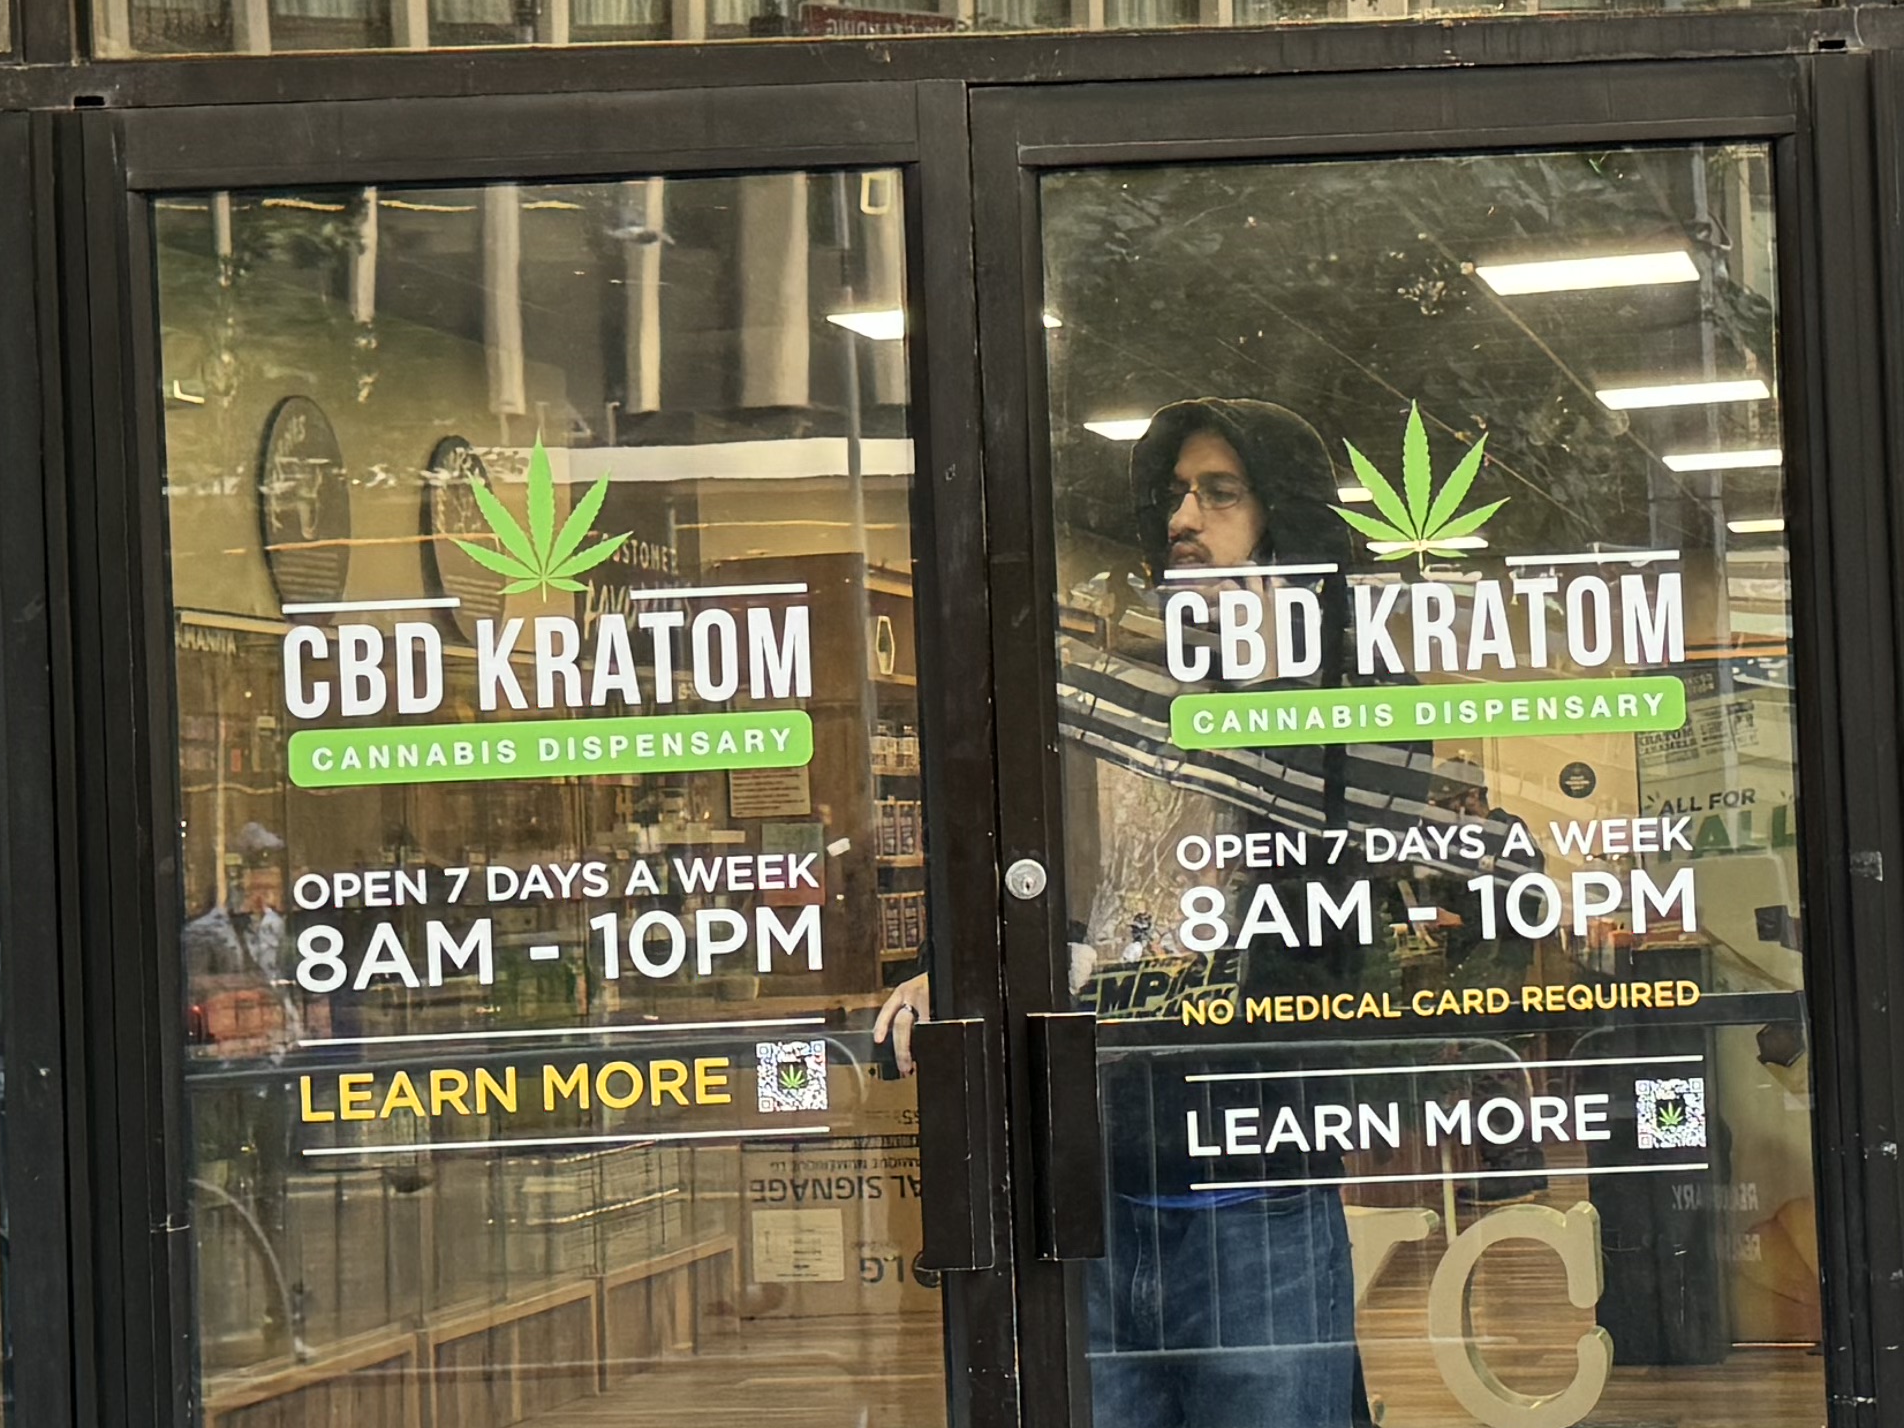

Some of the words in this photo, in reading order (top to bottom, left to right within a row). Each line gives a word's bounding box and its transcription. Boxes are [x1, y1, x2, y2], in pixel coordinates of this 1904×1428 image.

[1165, 587, 1324, 683] CBD
[1354, 572, 1686, 676] KRATOM
[282, 622, 444, 720] CBD
[476, 606, 813, 711] KRATOM
[1192, 703, 1395, 735] CANNABIS
[1415, 693, 1665, 726] DISPENSARY
[311, 739, 518, 771] CANNABIS
[539, 727, 792, 762] DISPENSARY
[1175, 831, 1307, 871] OPEN
[1322, 829, 1348, 865] 7
[1366, 824, 1486, 862] DAYS
[1501, 822, 1535, 859] A
[1549, 816, 1694, 856] WEEK
[293, 868, 428, 910] OPEN
[443, 867, 469, 904] 7
[487, 862, 610, 902] DAYS
[624, 860, 660, 895] A
[673, 852, 820, 895] WEEK
[1177, 880, 1373, 952] 8AM
[1407, 906, 1438, 923] -
[1467, 868, 1697, 942] 10PM
[295, 918, 494, 994] 8AM
[528, 944, 560, 962] -
[589, 904, 823, 980] 10PM
[1181, 998, 1235, 1027] NO
[1245, 991, 1402, 1024] MEDICAL
[1411, 987, 1511, 1019] CARD
[1521, 980, 1702, 1014] REQUIRED
[299, 1066, 517, 1123] LEARN
[542, 1057, 732, 1113] MORE
[1185, 1102, 1400, 1157] LEARN
[1425, 1094, 1611, 1148] MORE
[749, 1176, 883, 1203] SIGNAGE
